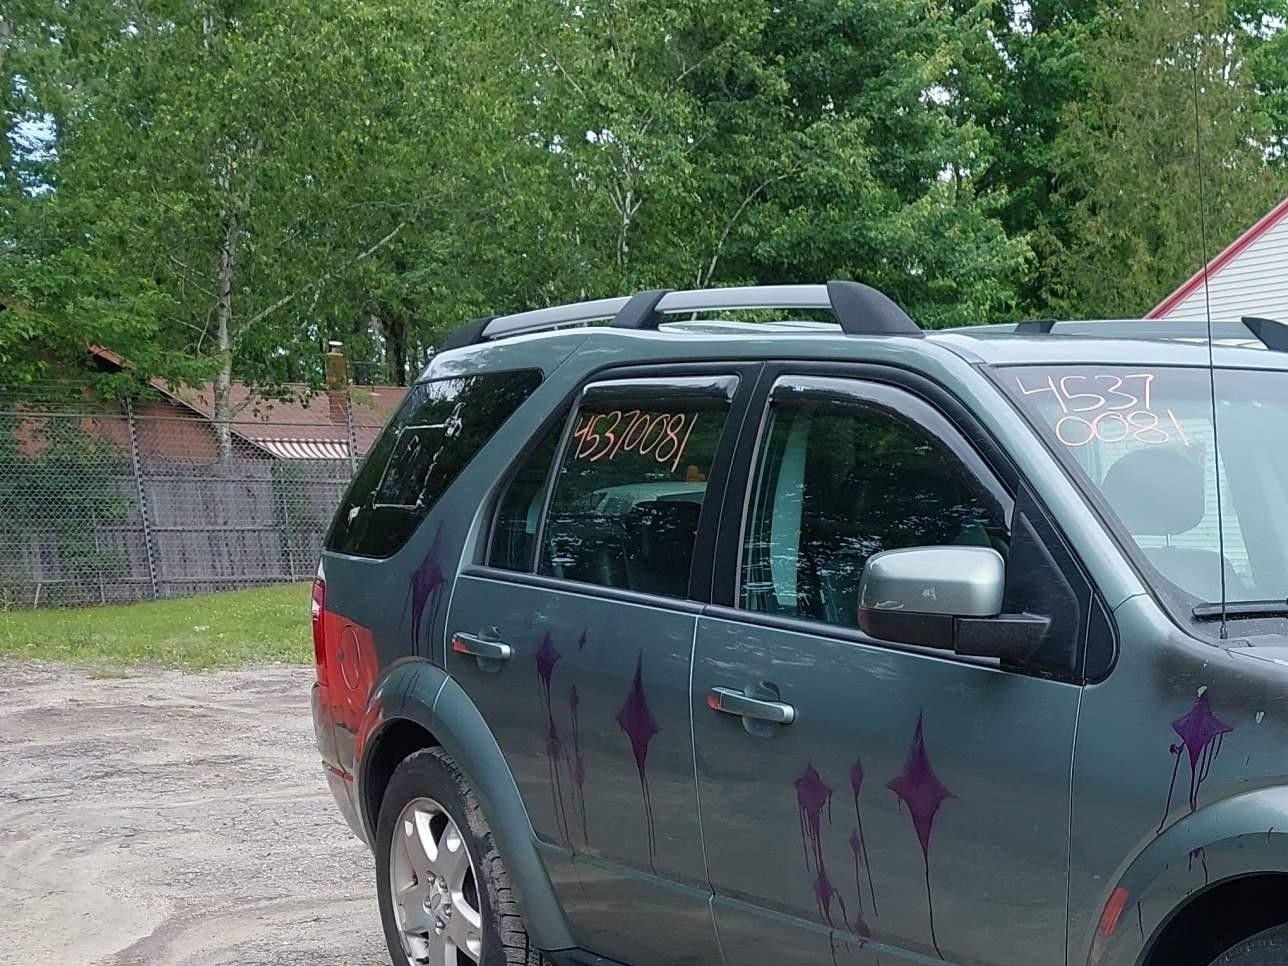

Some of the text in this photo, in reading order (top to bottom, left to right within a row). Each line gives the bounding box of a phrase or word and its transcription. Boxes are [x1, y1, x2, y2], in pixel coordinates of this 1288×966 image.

[1016, 373, 1154, 413] 4537
[574, 409, 699, 473] 45370081
[1055, 409, 1190, 447] 0081
